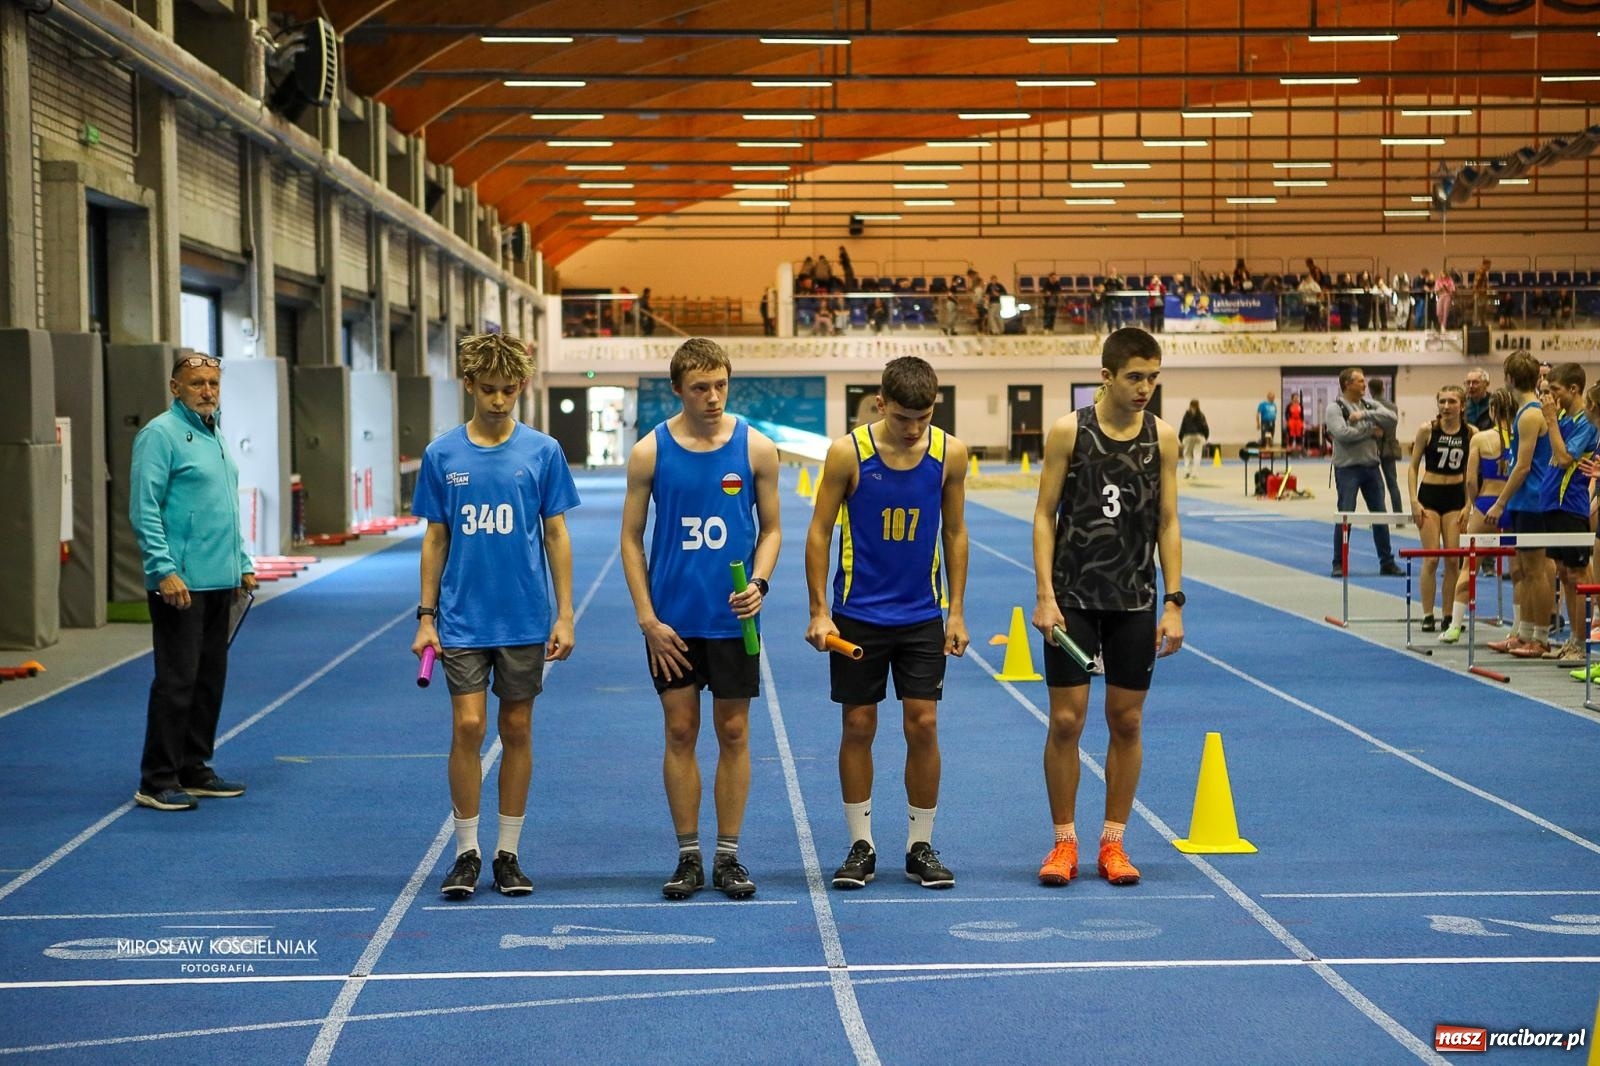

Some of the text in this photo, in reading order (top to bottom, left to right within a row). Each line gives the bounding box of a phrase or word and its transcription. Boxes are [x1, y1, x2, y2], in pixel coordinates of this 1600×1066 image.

[1437, 447, 1464, 470] 79
[1102, 484, 1121, 518] 3
[461, 503, 513, 535] 340
[681, 516, 728, 550] 30
[881, 507, 920, 541] 107
